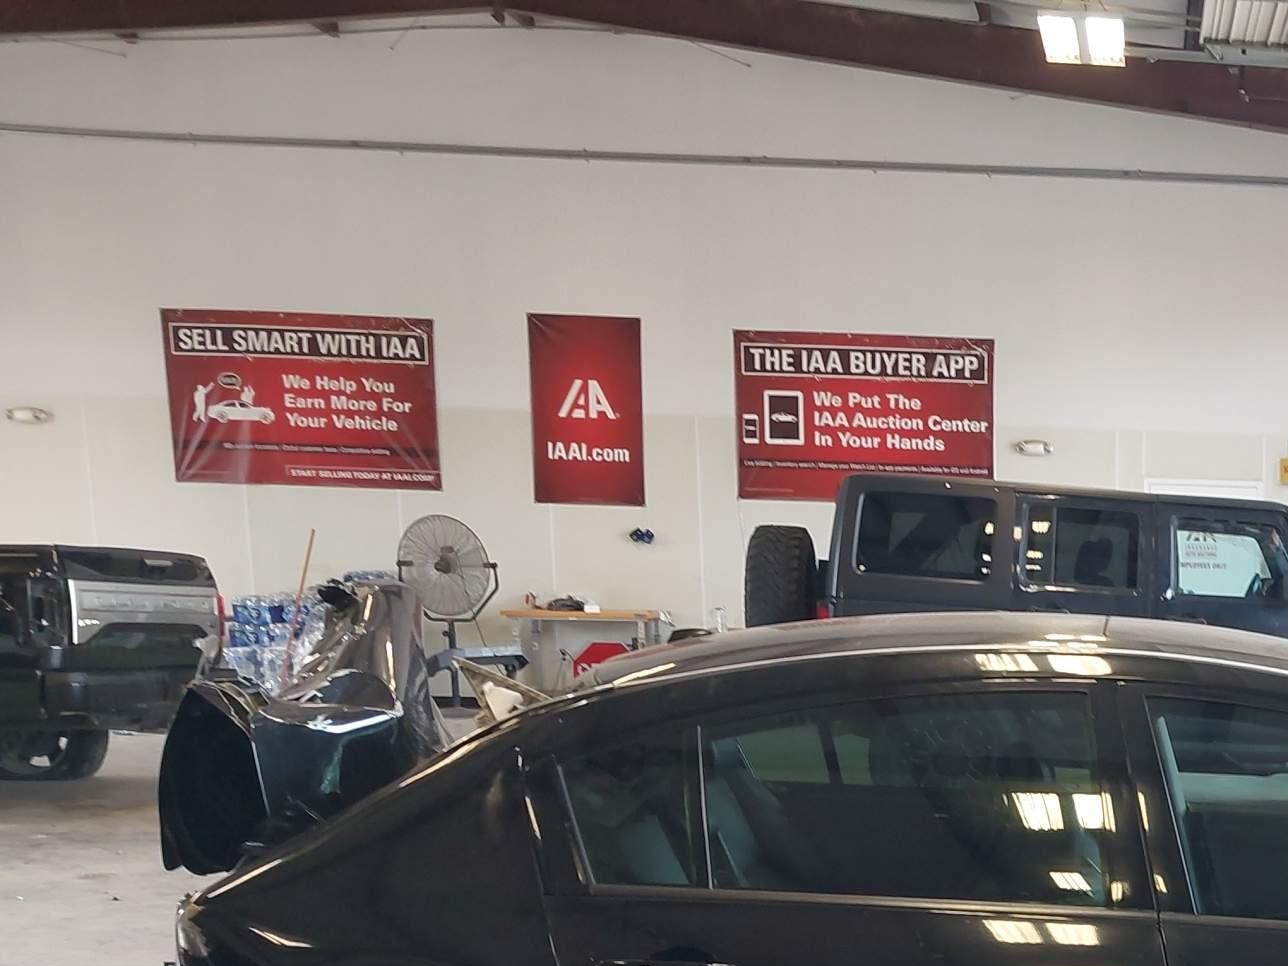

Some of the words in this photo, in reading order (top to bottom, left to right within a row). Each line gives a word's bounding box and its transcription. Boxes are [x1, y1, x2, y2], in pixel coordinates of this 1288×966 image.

[177, 328, 229, 351] SELL
[233, 331, 312, 354] SMART
[316, 334, 376, 356] WITH
[381, 336, 422, 359] IAA
[749, 348, 796, 372] THE
[801, 350, 844, 374] IAA
[850, 351, 928, 376] BUYER
[932, 354, 979, 379] APP
[281, 374, 312, 390] We
[316, 376, 357, 394] Help
[360, 377, 395, 394] You
[284, 395, 326, 410] Earn
[331, 397, 377, 412] More
[383, 398, 412, 413] For
[813, 391, 842, 407] We
[848, 392, 881, 409] Put
[886, 393, 922, 411] The
[285, 413, 328, 429] Your
[332, 414, 399, 432] Vehicle
[813, 411, 849, 428] IAA
[852, 413, 924, 431] Auction
[927, 415, 989, 433] Center
[814, 430, 833, 447] In
[837, 432, 882, 449] Your
[886, 434, 945, 451] Hands
[547, 441, 630, 462] IAAI.com
